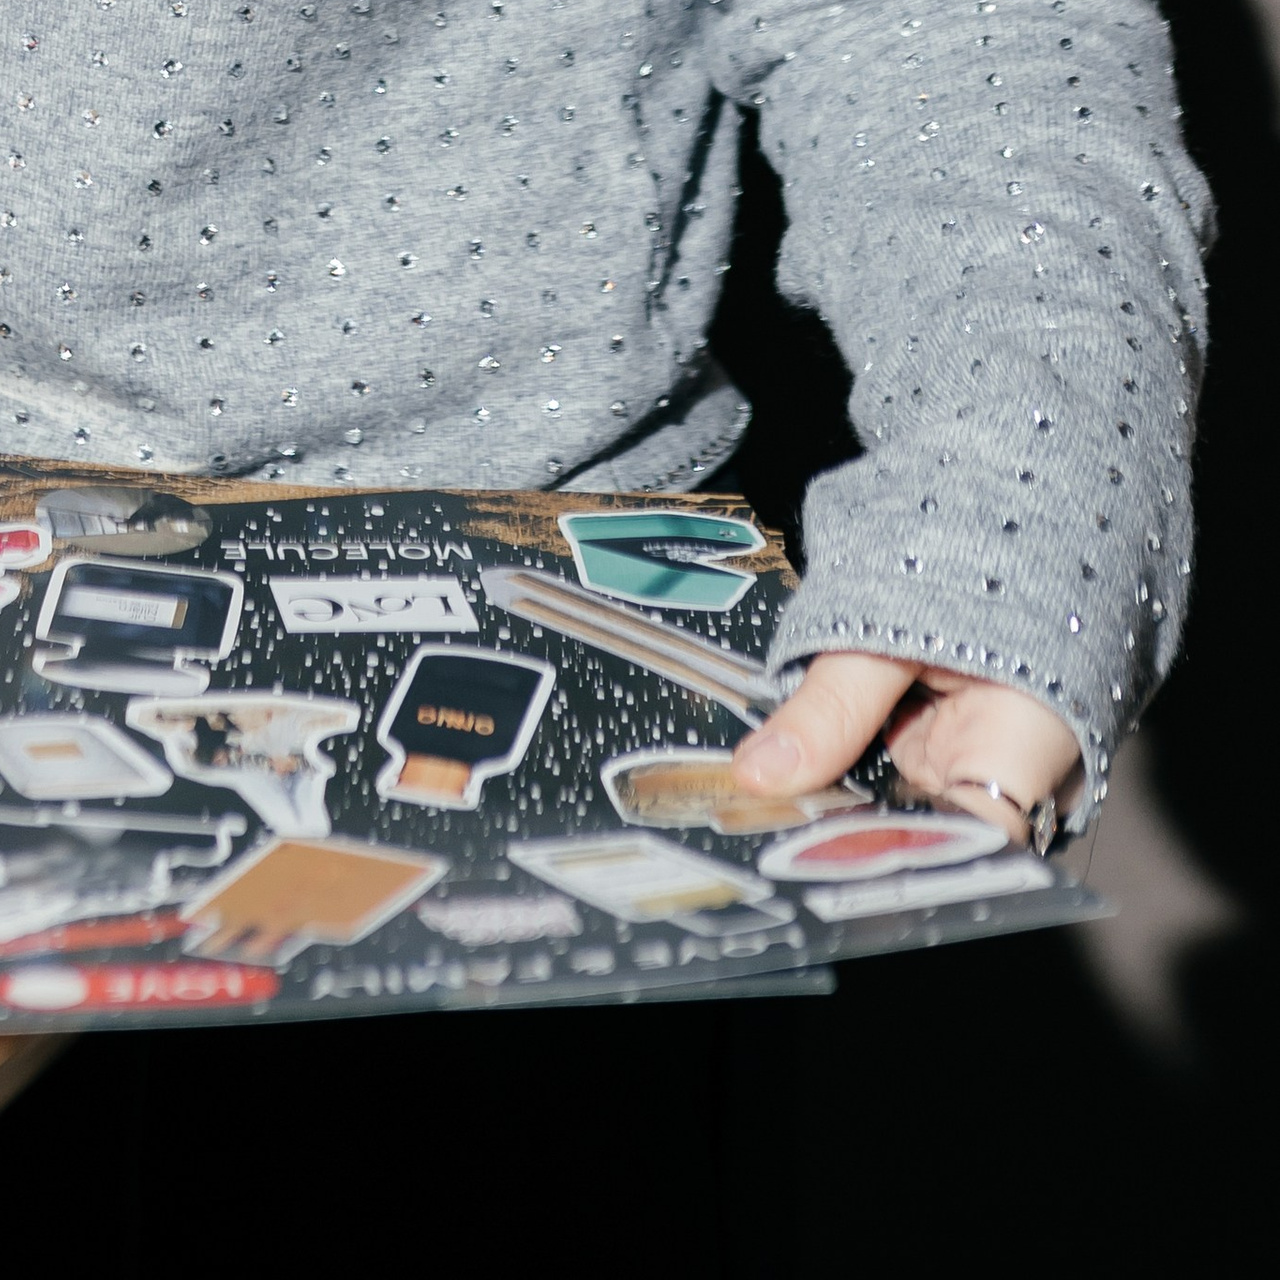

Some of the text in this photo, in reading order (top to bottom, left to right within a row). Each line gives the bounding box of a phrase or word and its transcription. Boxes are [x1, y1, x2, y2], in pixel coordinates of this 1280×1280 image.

[220, 541, 473, 560] MOLECULE
[311, 923, 806, 1001] LOVE & FAMILY
[106, 965, 244, 1002] LOVE
